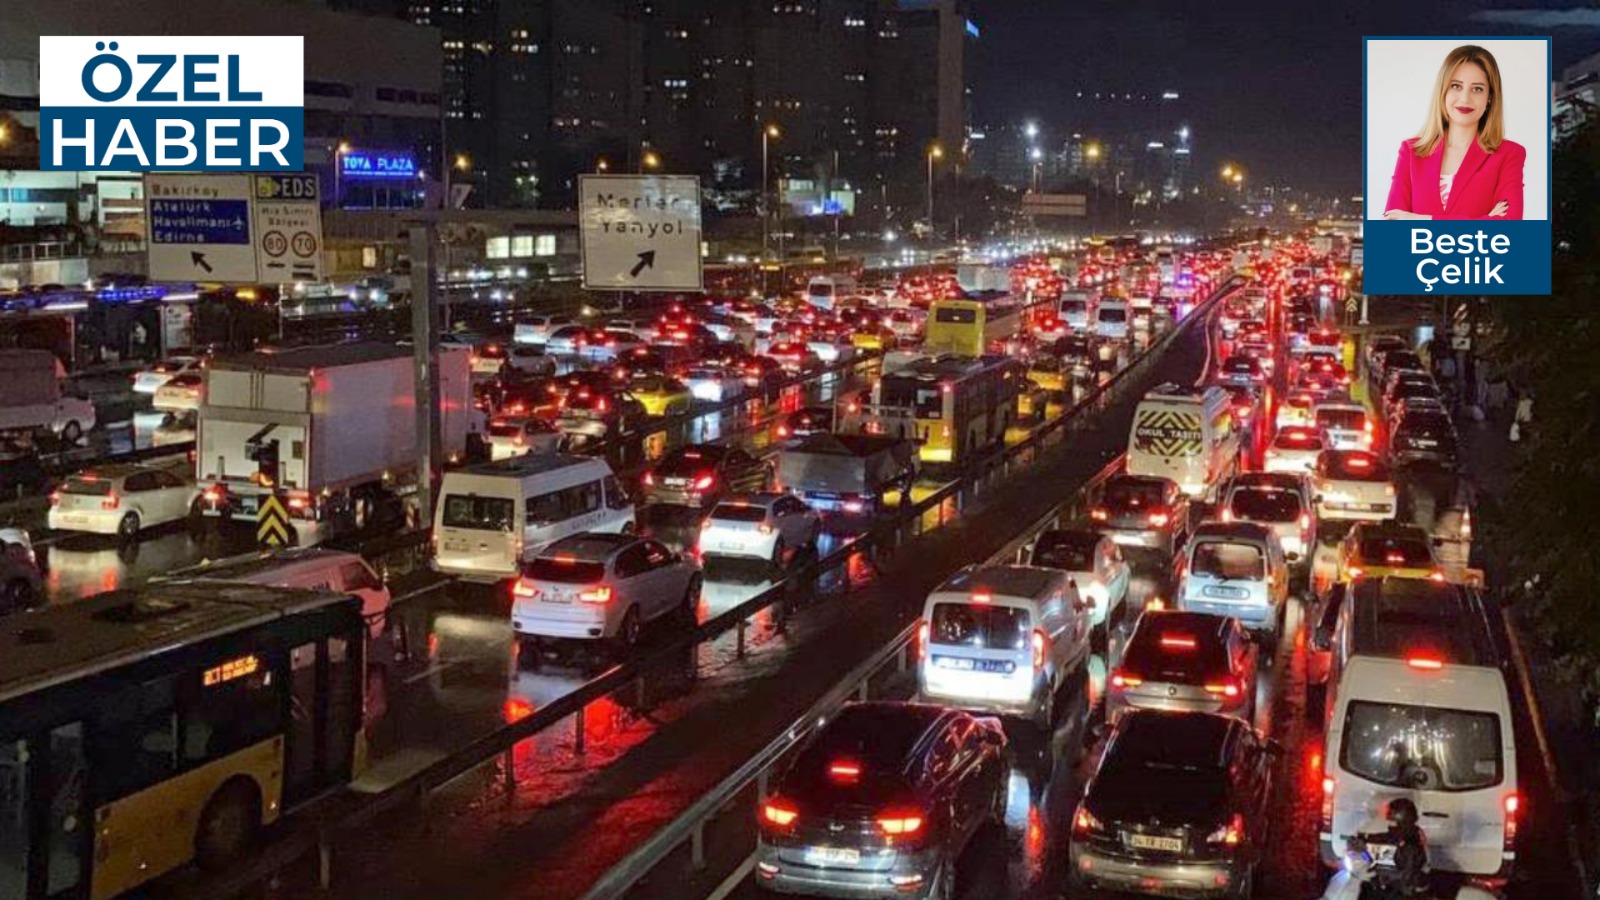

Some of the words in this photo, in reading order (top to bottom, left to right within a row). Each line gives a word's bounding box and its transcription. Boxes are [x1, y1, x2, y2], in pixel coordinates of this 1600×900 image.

[377, 157, 414, 171] PLAZA
[281, 177, 316, 198] EDS
[1137, 428, 1166, 438] OKUL
